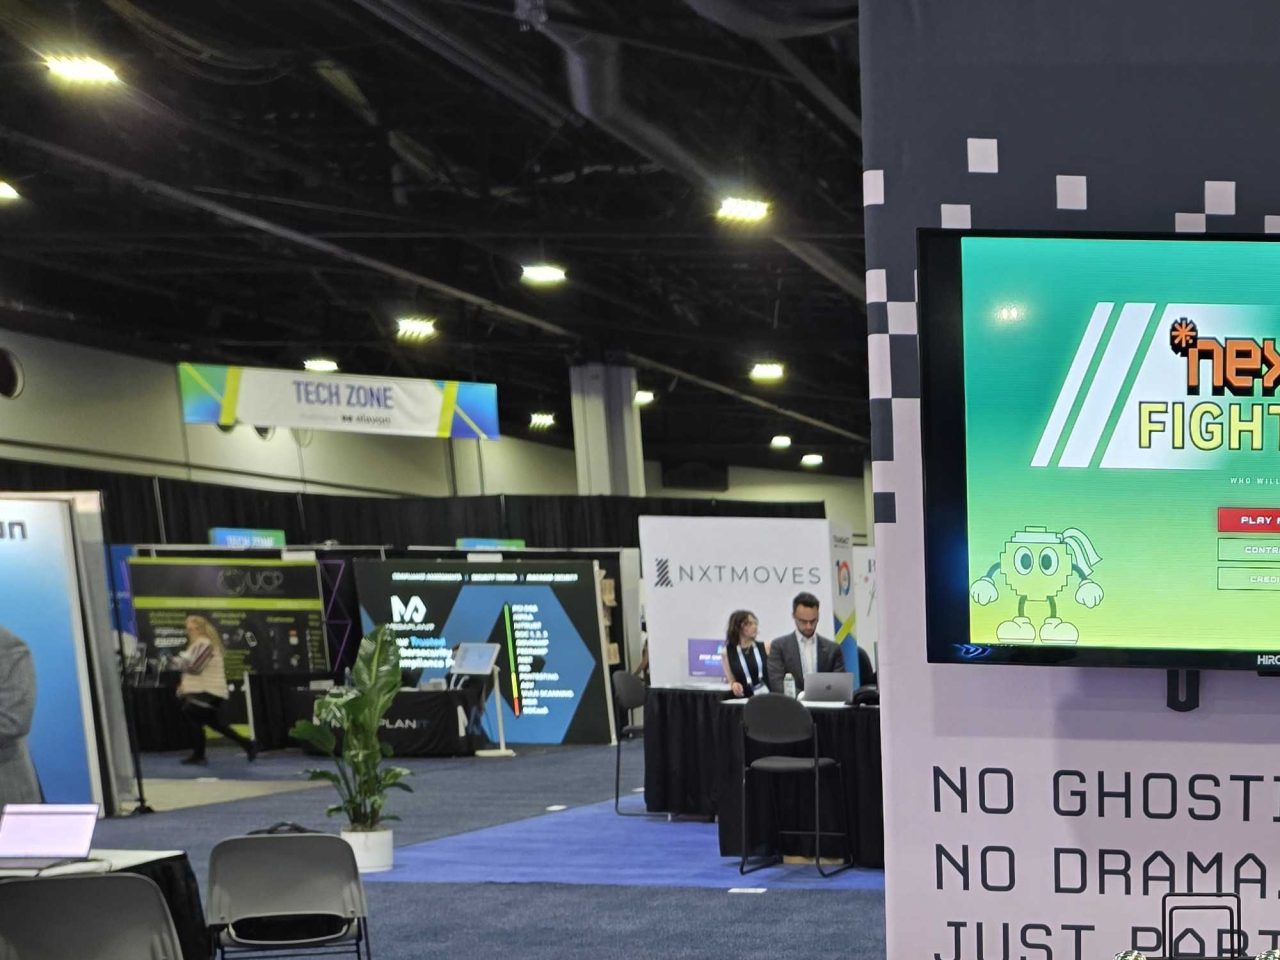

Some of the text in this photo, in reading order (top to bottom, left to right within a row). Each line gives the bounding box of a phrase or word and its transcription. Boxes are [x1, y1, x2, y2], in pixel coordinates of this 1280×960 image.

[293, 379, 395, 409] TECH ZONE
[1230, 477, 1251, 485] WHO
[1240, 516, 1273, 525] PLAY
[678, 564, 823, 585] NXTMOVES
[932, 766, 1014, 815] NO
[935, 844, 1015, 892] NO
